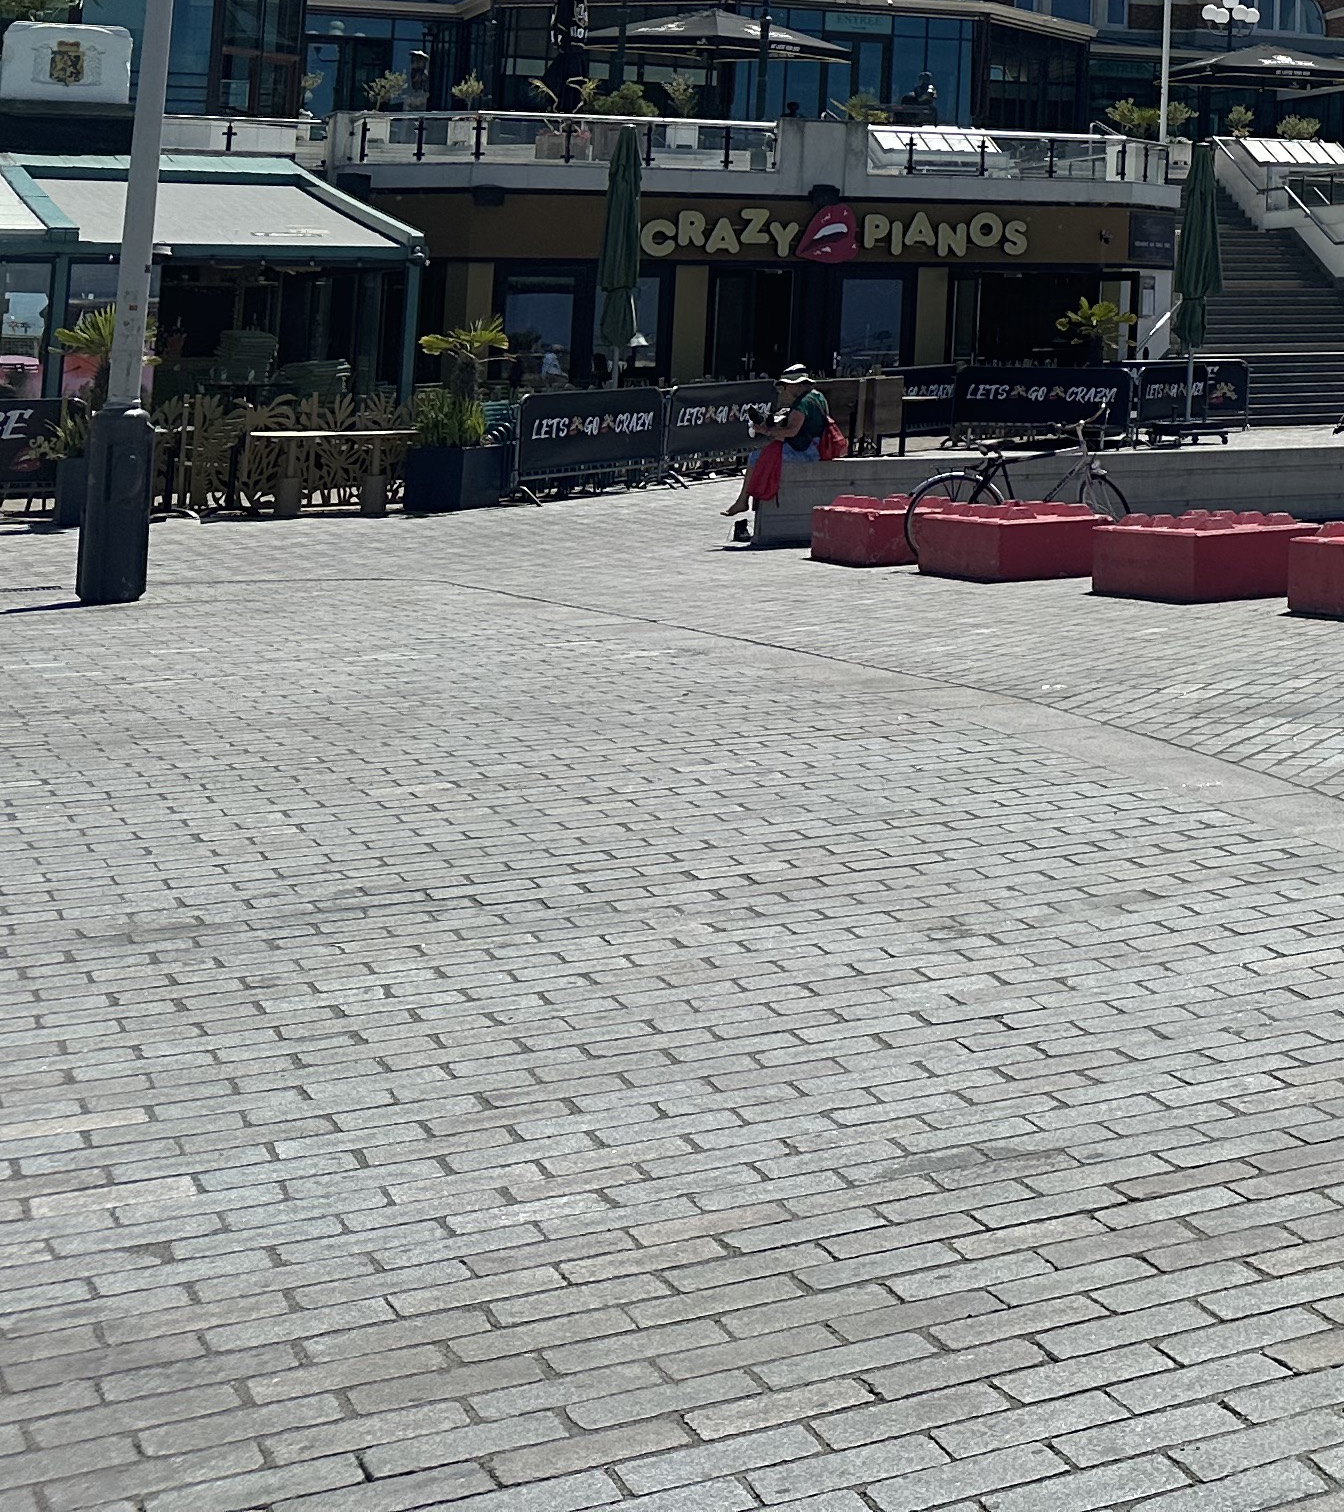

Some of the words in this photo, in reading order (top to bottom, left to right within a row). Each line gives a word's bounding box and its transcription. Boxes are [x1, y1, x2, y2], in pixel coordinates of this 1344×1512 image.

[639, 207, 800, 258] CRAZY
[863, 211, 1028, 256] PIANOS
[966, 383, 1010, 400] LETS
[1027, 386, 1047, 401] GO
[1066, 386, 1117, 404] CRAZY!
[1146, 383, 1164, 399] LETS
[532, 418, 569, 439] LETS
[584, 416, 599, 435] GO
[614, 411, 654, 435] CRAZY!
[677, 406, 704, 427] LETS
[715, 405, 729, 423] GO
